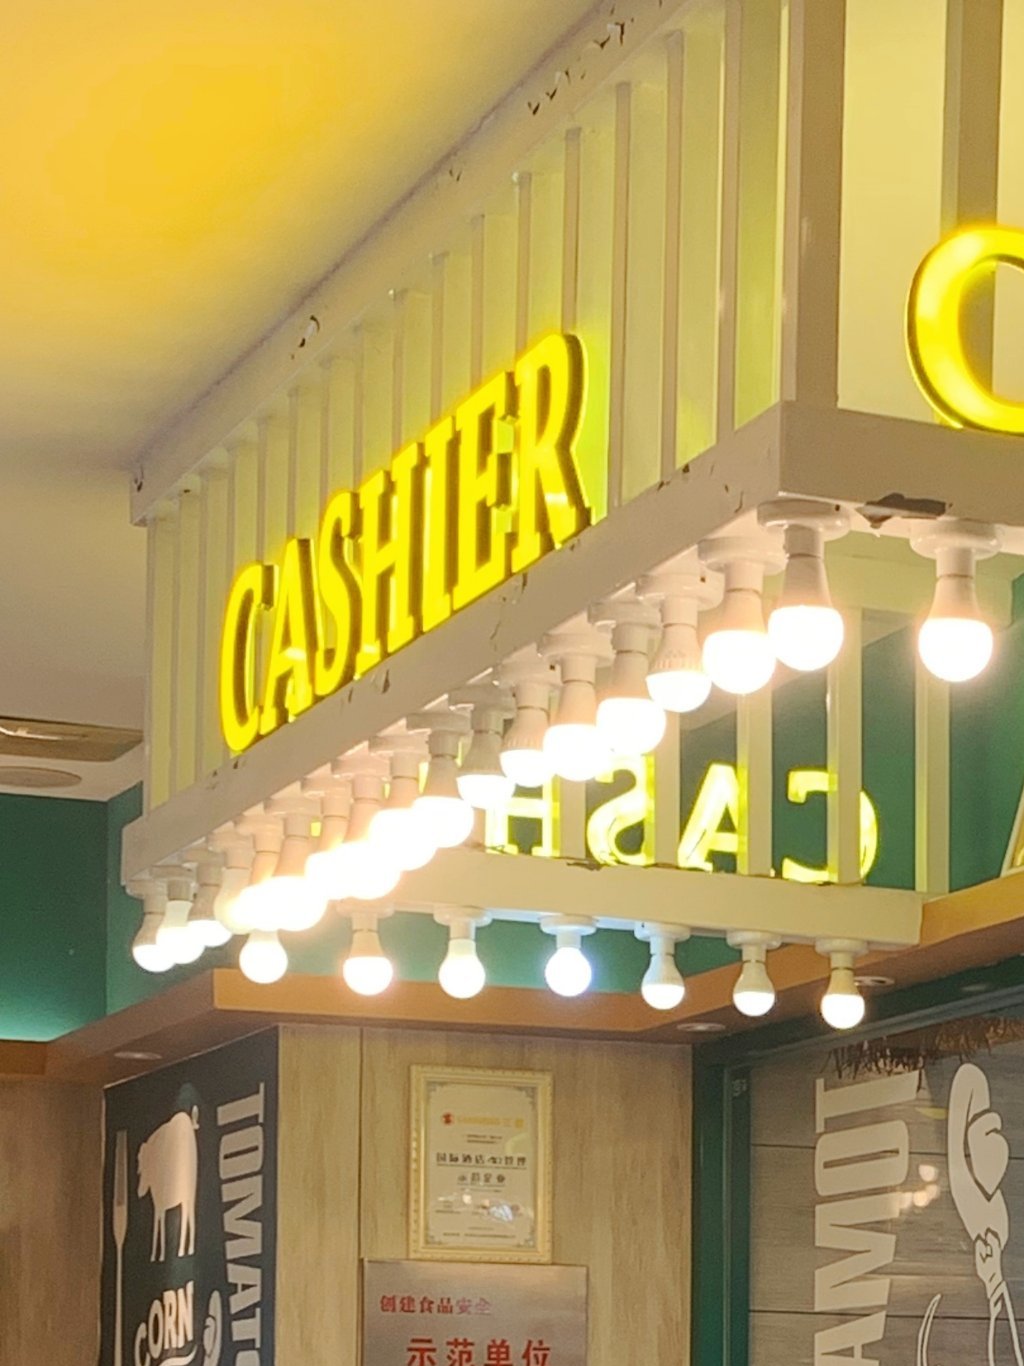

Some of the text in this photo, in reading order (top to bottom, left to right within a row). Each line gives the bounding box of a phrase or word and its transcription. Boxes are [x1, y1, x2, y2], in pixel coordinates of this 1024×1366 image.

[218, 331, 597, 754] CASHIER
[379, 1295, 492, 1316] 创建食品安全
